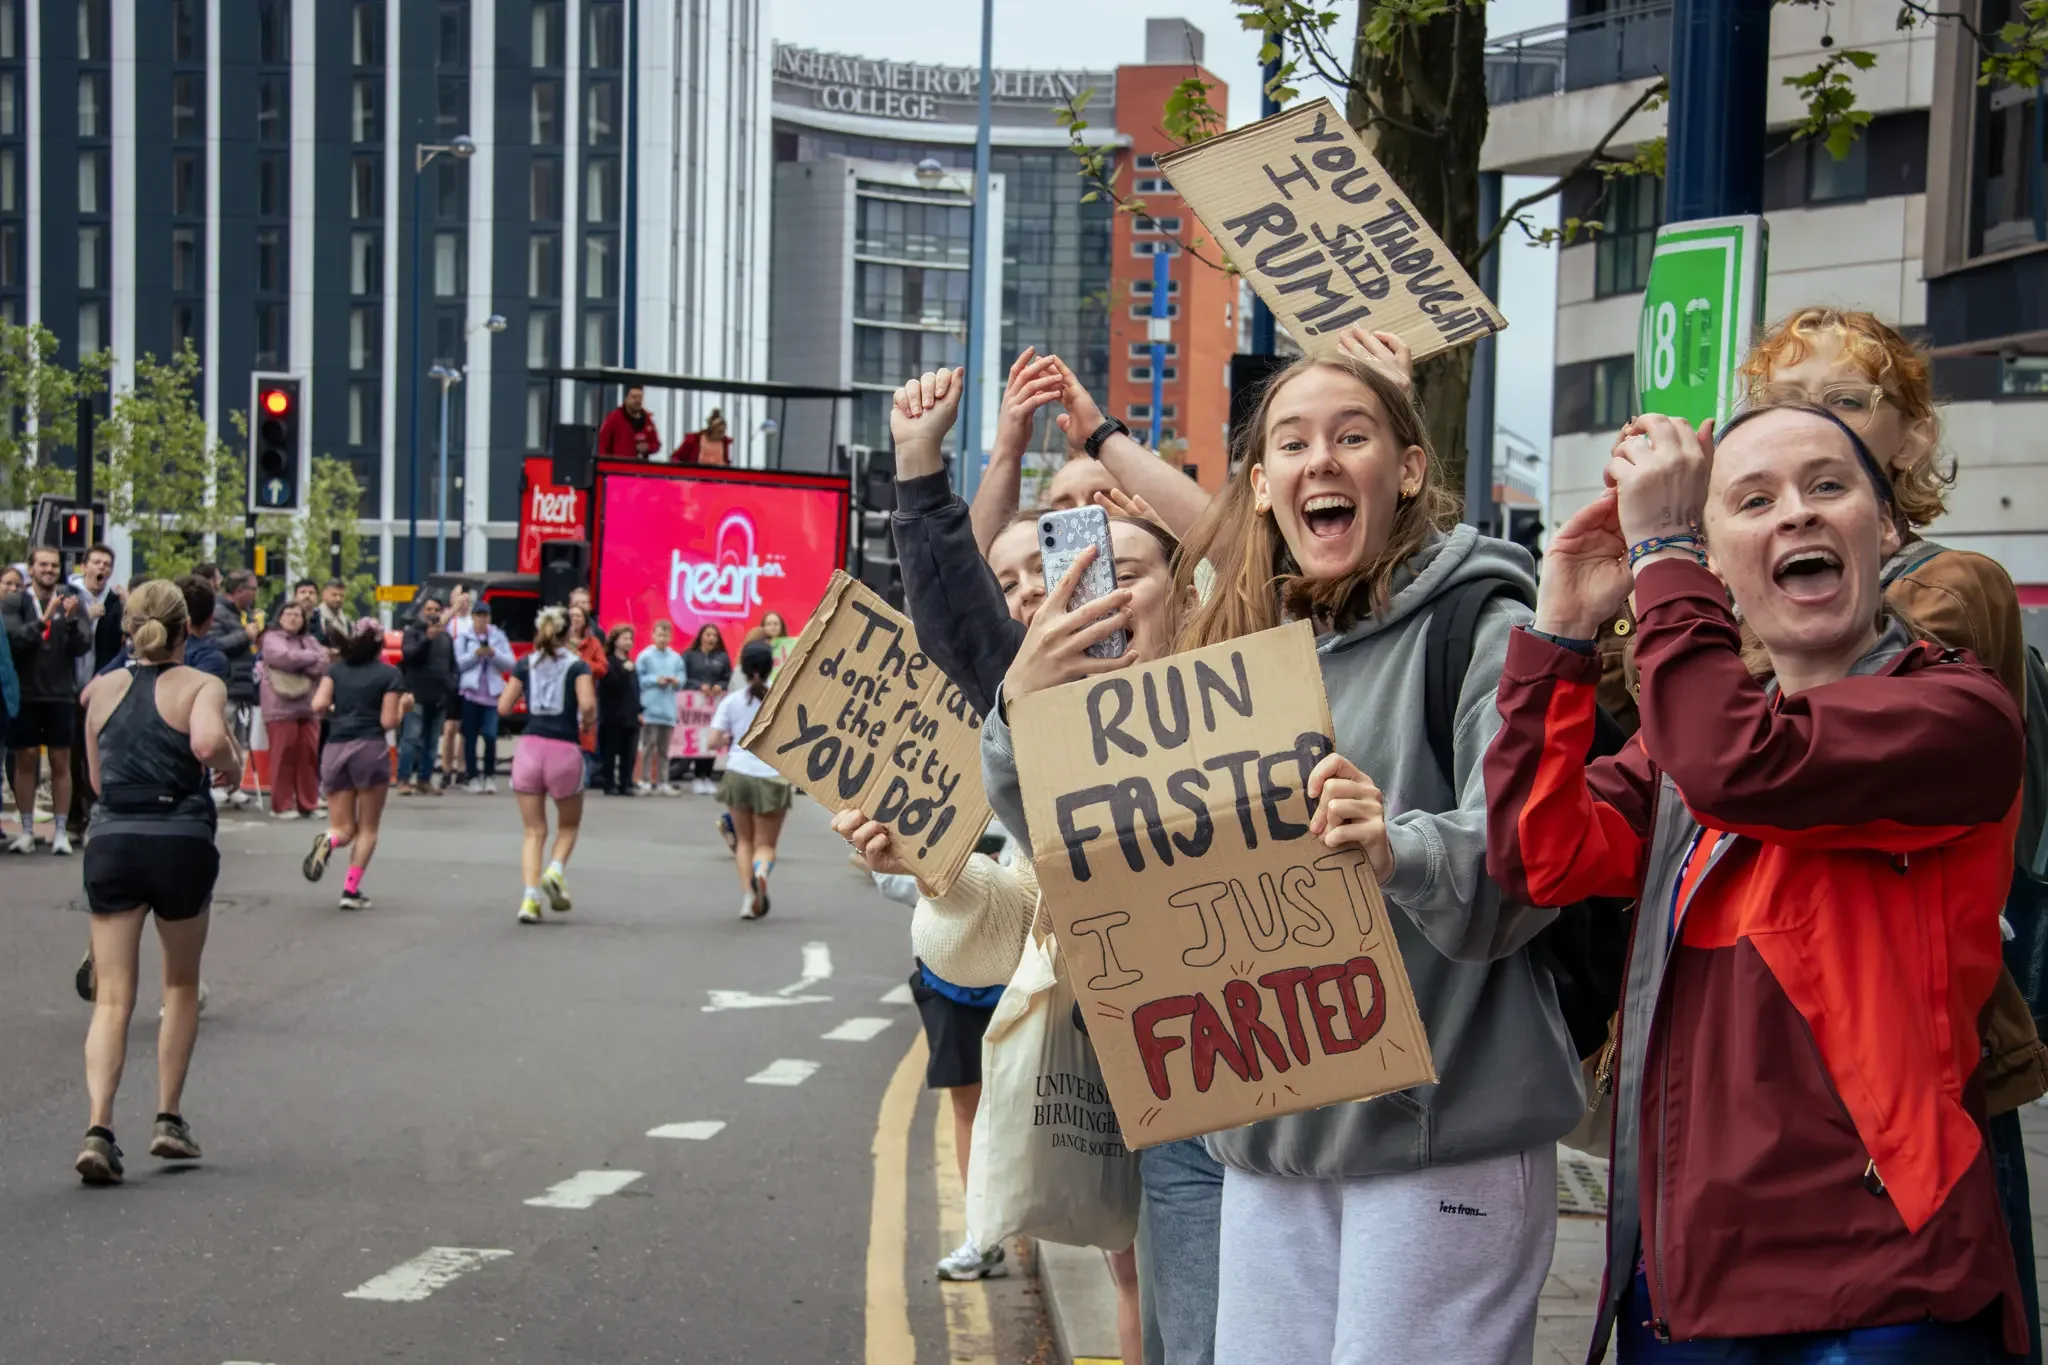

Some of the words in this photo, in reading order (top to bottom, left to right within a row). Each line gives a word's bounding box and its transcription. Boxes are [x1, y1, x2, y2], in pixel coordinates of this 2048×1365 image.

[822, 85, 937, 120] COLLEGE
[1262, 154, 1321, 201] I
[1310, 222, 1390, 300] SAID
[1294, 112, 1383, 205] YOU
[1362, 198, 1498, 344] THOUGHT
[532, 485, 578, 523] heart
[671, 548, 763, 606] heart
[852, 600, 929, 690] The
[818, 648, 891, 707] don't
[894, 700, 939, 741] run
[836, 697, 887, 748] the
[1086, 651, 1253, 766] RUN
[777, 703, 875, 801] YOU
[872, 775, 957, 860] DO!
[1070, 910, 1144, 990] I
[1168, 848, 1373, 968] JUST
[1132, 955, 1387, 1100] FARTED
[1033, 1103, 1121, 1134] BIRMINGH
[1052, 1133, 1087, 1154] DANCE
